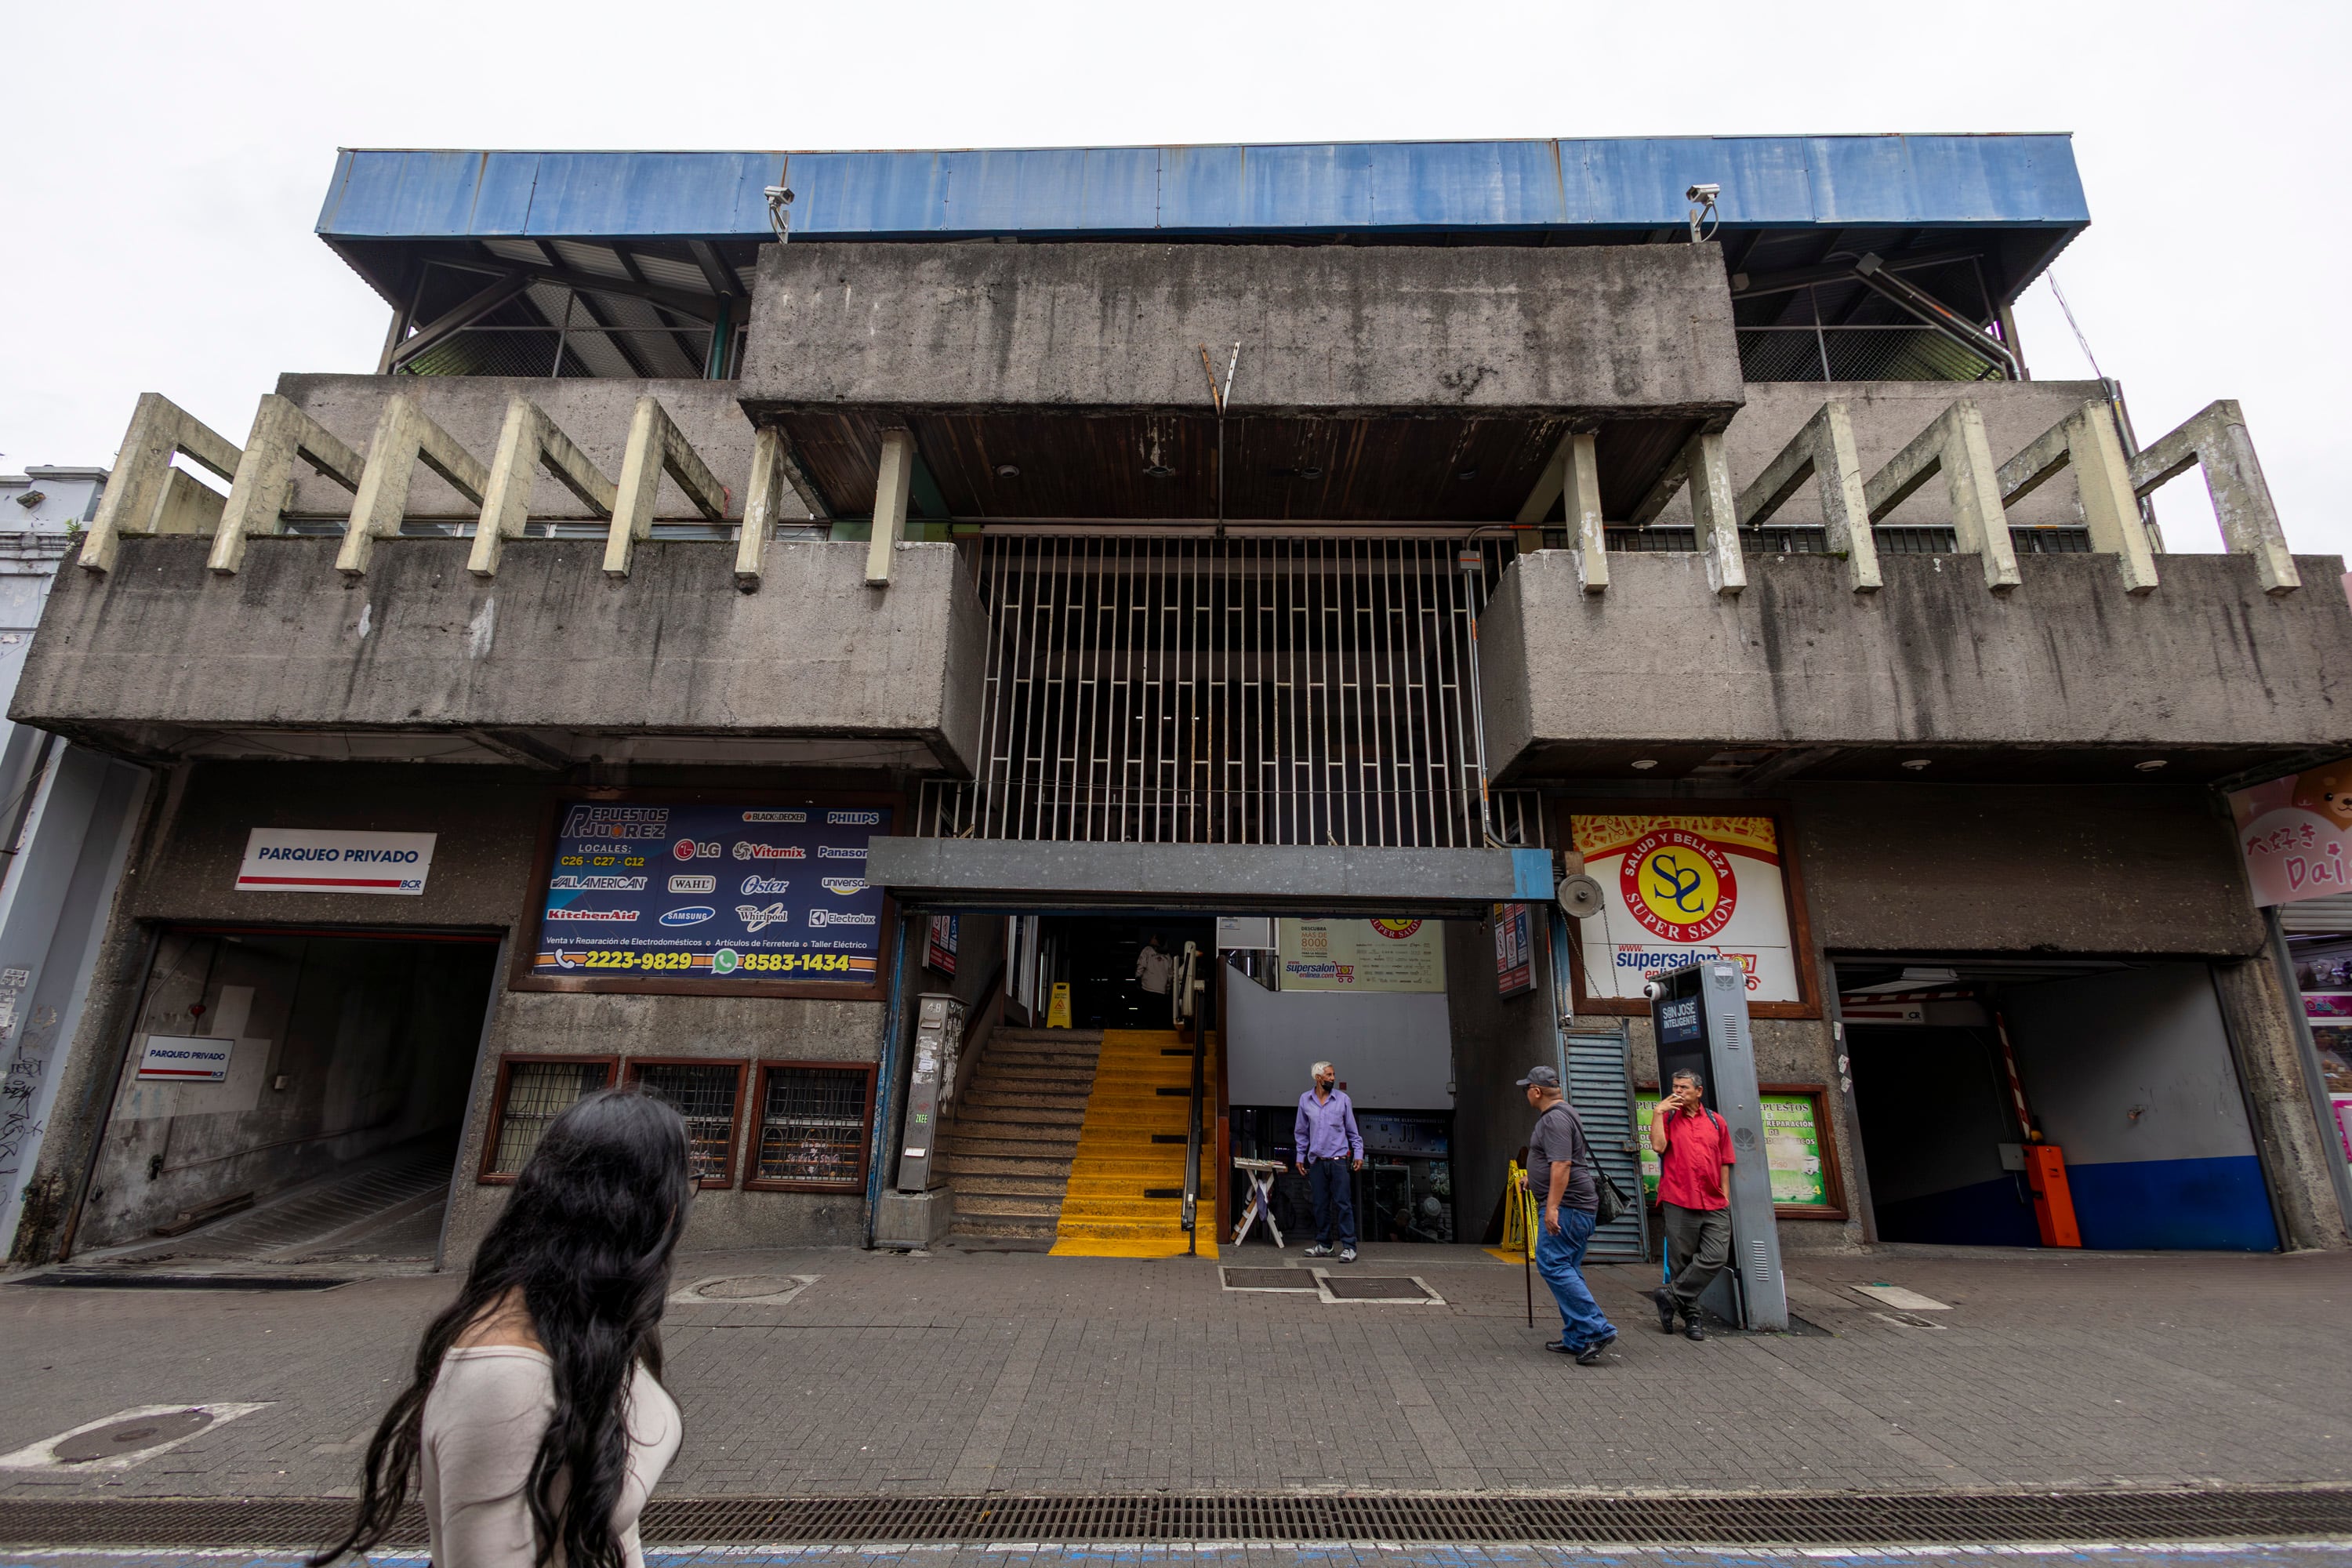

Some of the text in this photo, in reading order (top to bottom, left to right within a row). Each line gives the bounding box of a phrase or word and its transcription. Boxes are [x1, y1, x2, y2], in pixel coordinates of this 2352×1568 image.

[561, 805, 669, 838] REPUESTOS
[753, 812, 805, 822] BLACK&DECKER
[828, 813, 878, 823] PHILIPS
[583, 822, 666, 838] JUREZ
[2247, 822, 2316, 855] 大好き
[579, 844, 632, 853] LOCALES:
[698, 844, 720, 856] LG
[752, 844, 804, 858] Vitamix
[258, 847, 419, 863] PARQUEO PRIVADO
[1625, 833, 1729, 879] SALUD Y BELLEZA
[561, 856, 583, 866] C26
[593, 857, 615, 866] C27
[624, 857, 645, 867] C12
[2285, 843, 2345, 891] Dai
[401, 880, 422, 888] BCR
[552, 877, 644, 890] ALL AMERICAN
[675, 879, 710, 889] WAHL
[742, 876, 789, 894] Oster
[823, 878, 869, 887] universa
[548, 910, 637, 920] KitchenAid
[739, 911, 786, 923] Whirlpool
[829, 913, 875, 924] Electrolux
[1626, 892, 1733, 939] SUPER SALON
[576, 937, 615, 946] Reparación
[631, 938, 702, 946] Electrodomésticos
[715, 938, 749, 947] Artículos
[763, 939, 800, 948] Ferretería
[1301, 938, 1327, 947] 8000
[585, 951, 850, 971] 2223-9829 8583-1434
[1286, 963, 1335, 975] supersalon
[1678, 1000, 1696, 1017] JOSÉ
[1663, 1014, 1697, 1029] INTELIGENTE
[149, 1050, 226, 1061] PARQUEO PRIVADO
